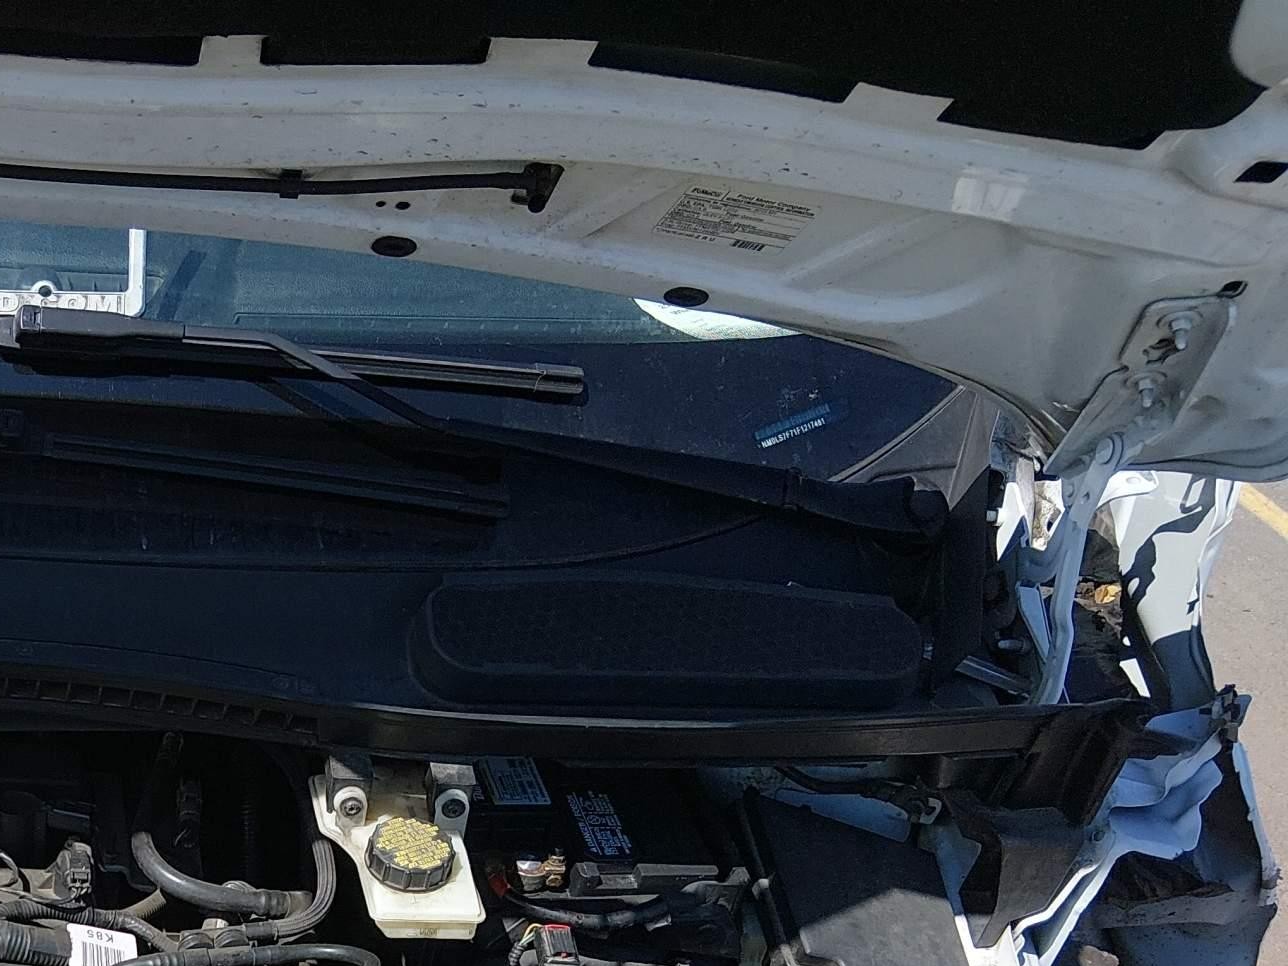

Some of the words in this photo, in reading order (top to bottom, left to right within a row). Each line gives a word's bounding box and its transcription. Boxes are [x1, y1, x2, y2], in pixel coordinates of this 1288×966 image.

[736, 193, 755, 201] Ford
[755, 197, 777, 205] Motor
[777, 201, 812, 212] Company
[86, 929, 114, 944] K85
